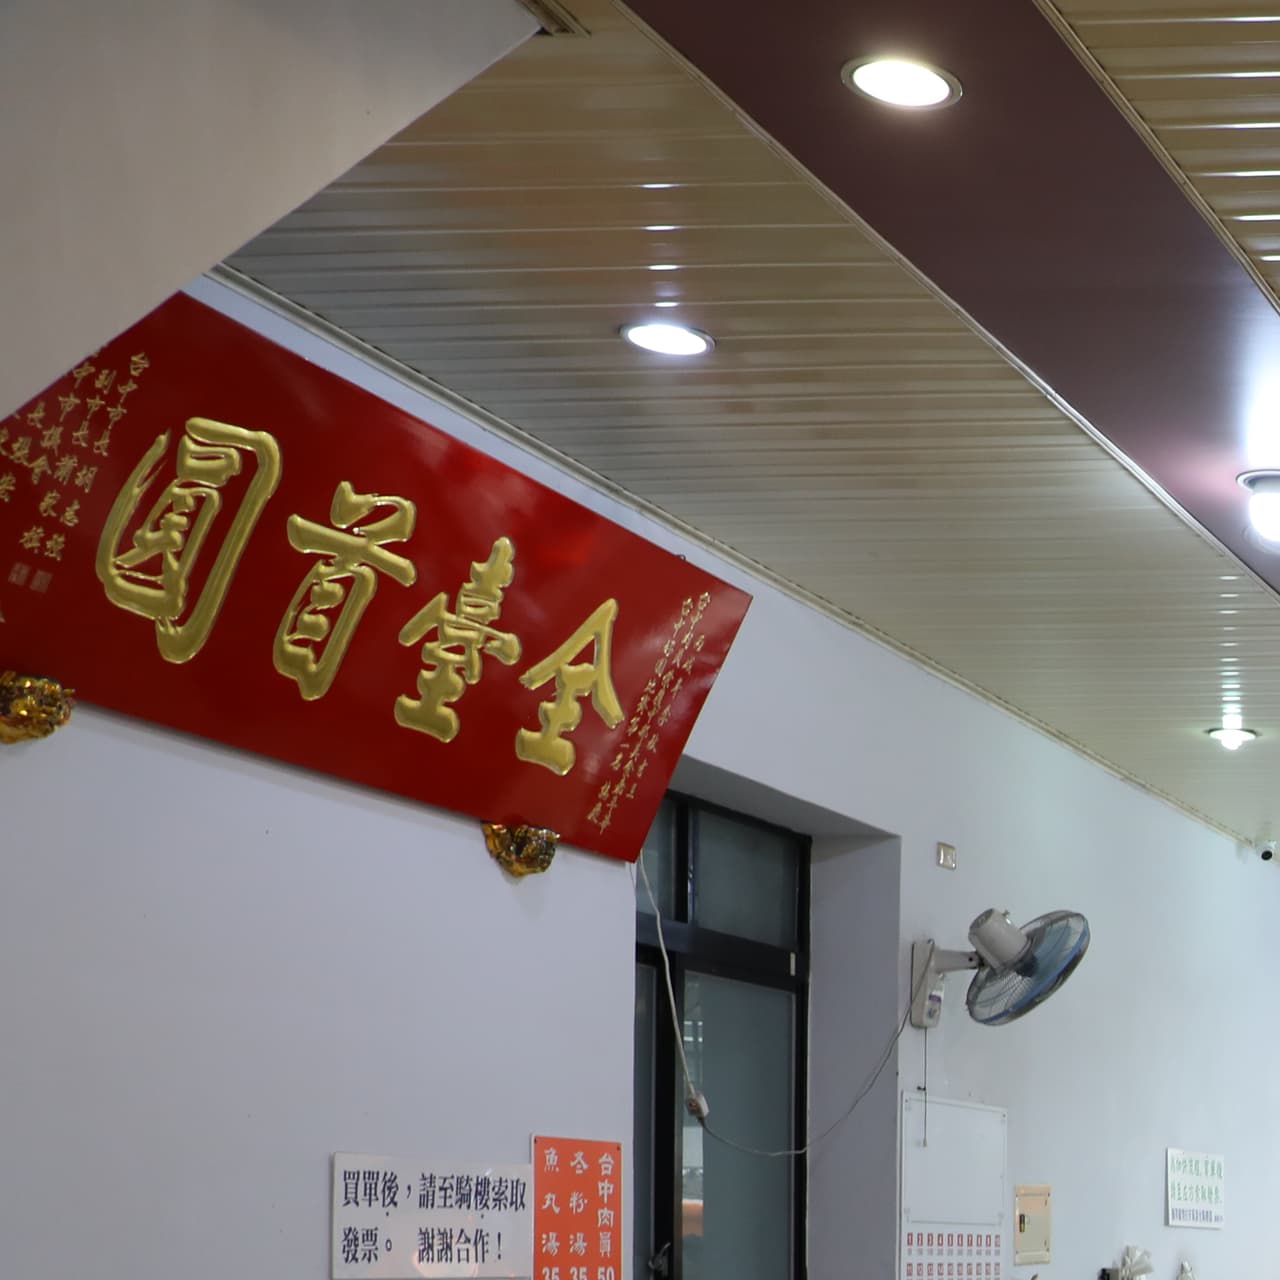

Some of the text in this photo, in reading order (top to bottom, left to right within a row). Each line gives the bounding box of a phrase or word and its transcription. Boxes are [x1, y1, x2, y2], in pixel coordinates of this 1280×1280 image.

[541, 1147, 561, 1256] 魚丸湯
[569, 1151, 588, 1256] 冬粉湯
[597, 1153, 614, 1258] 台中肉員
